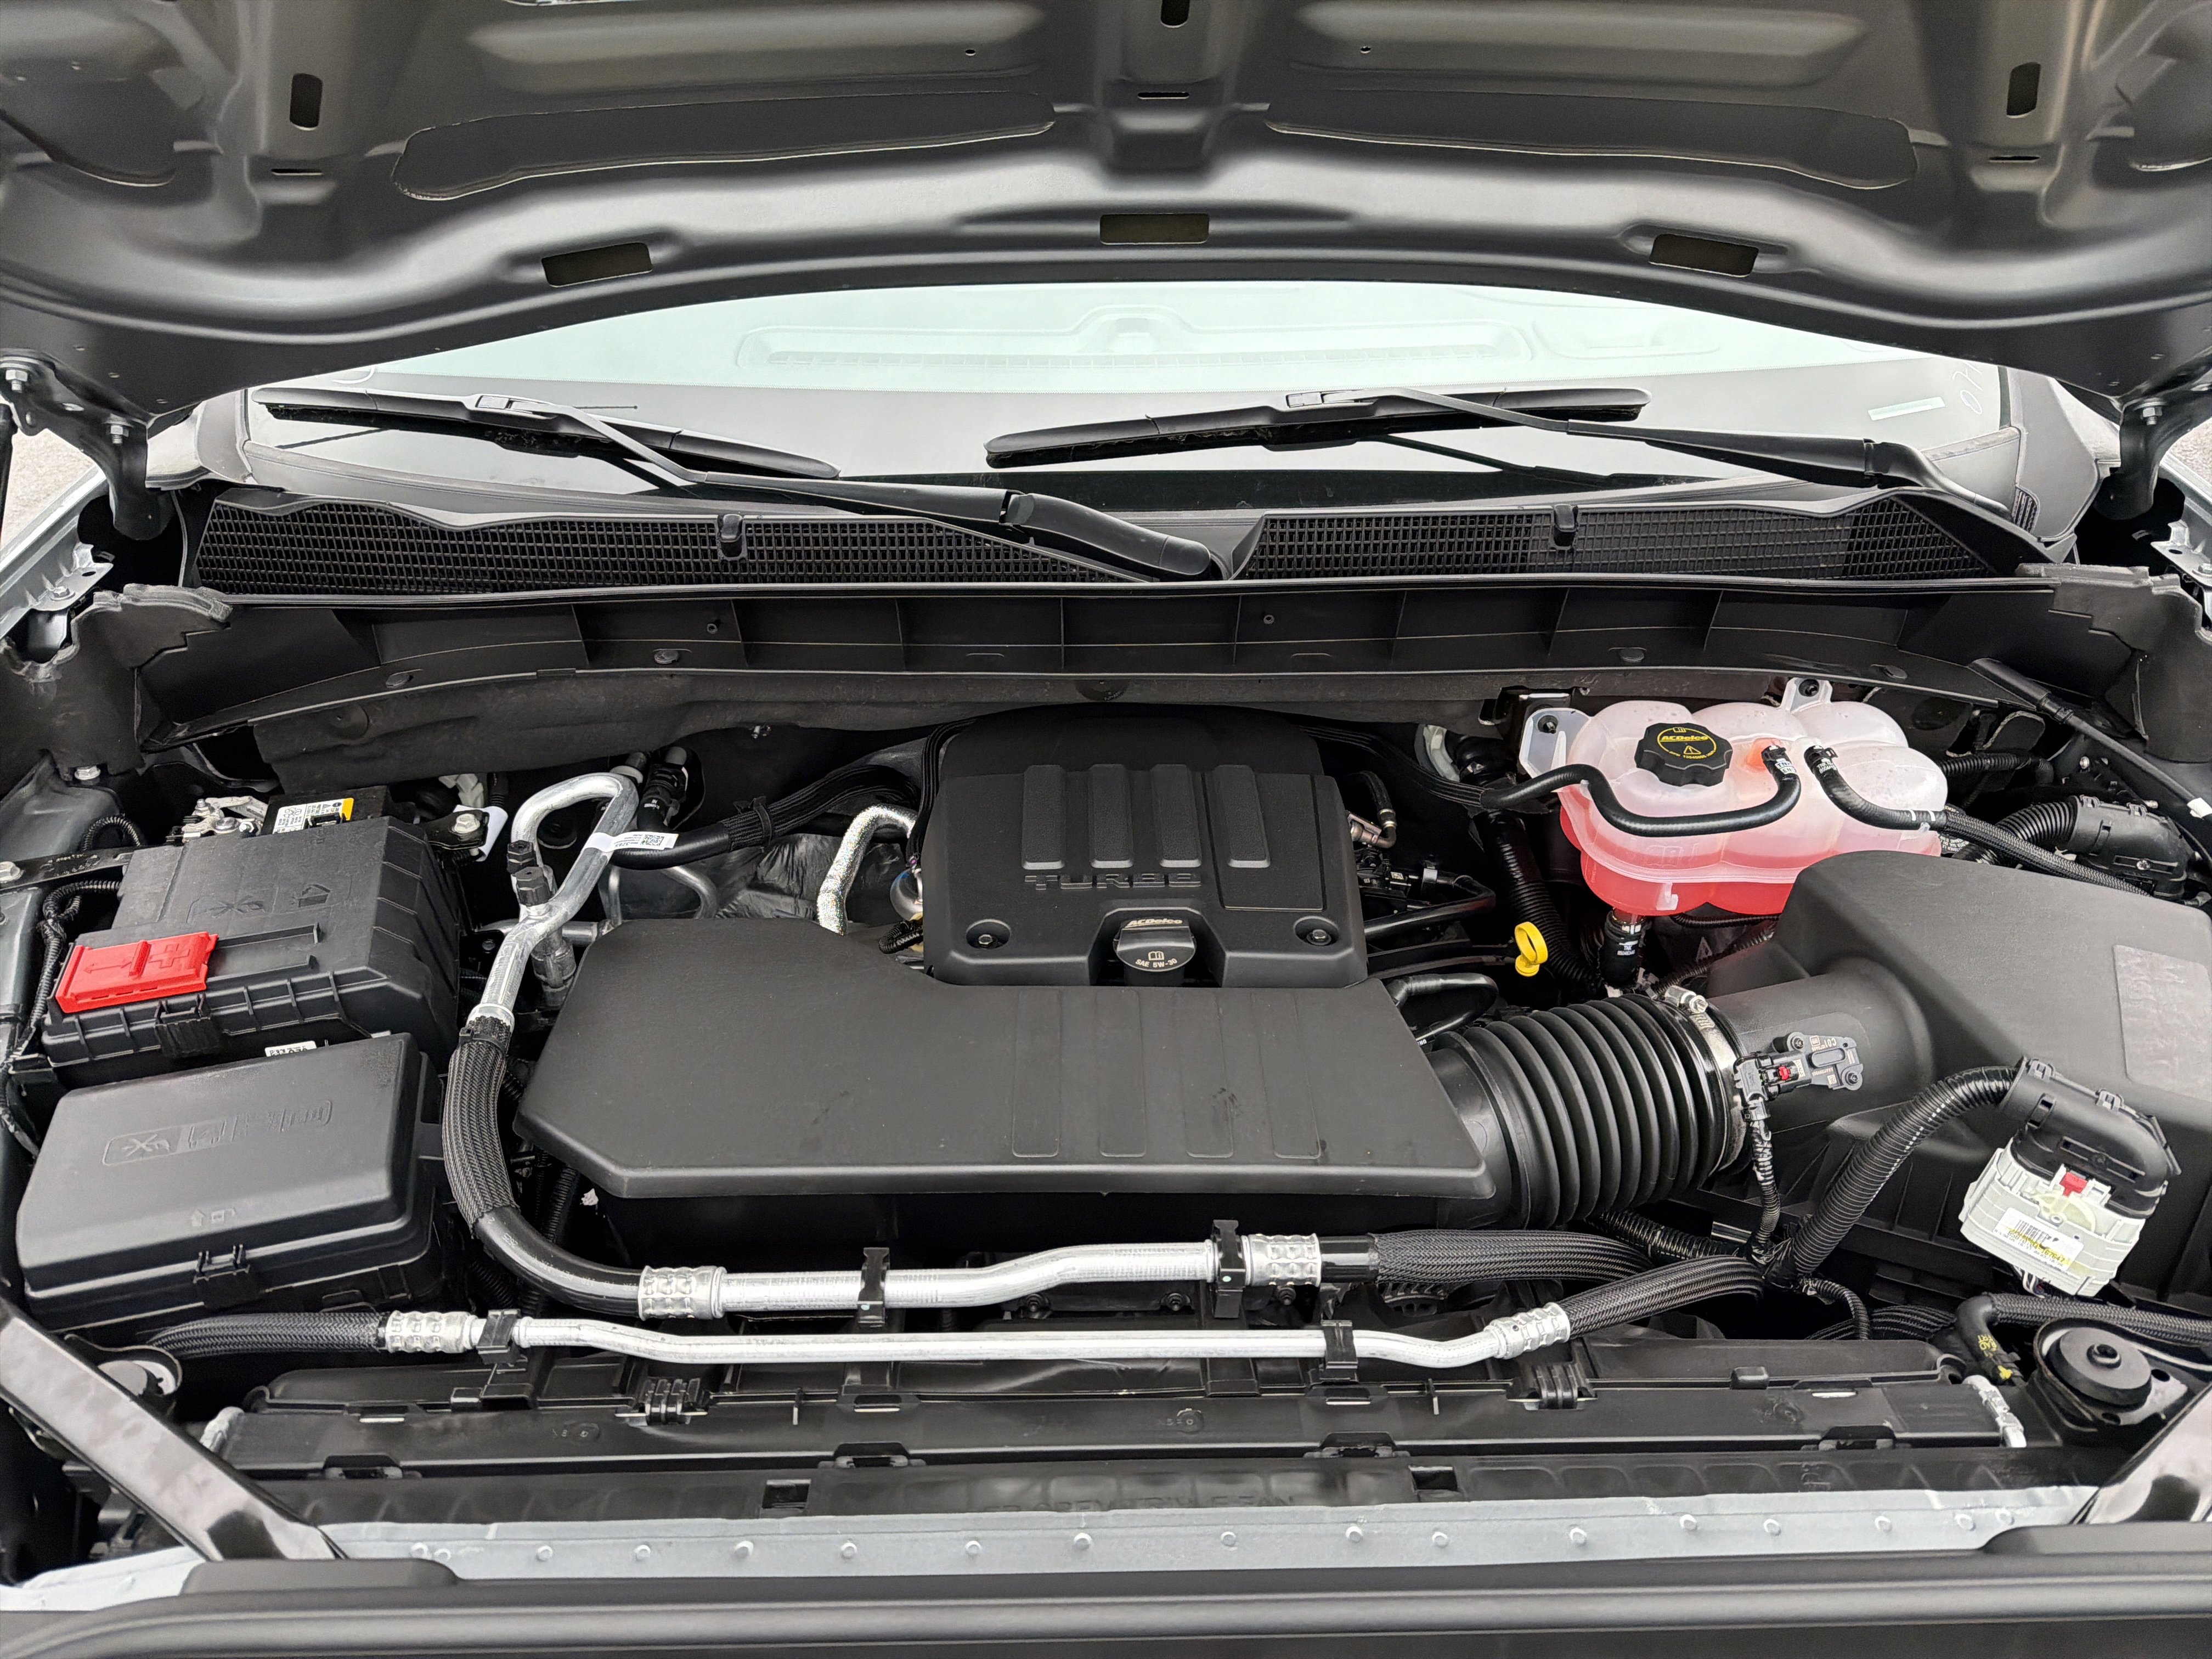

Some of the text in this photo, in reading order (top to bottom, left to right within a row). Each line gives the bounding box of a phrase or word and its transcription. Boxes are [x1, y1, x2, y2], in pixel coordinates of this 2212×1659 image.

[1125, 918, 1183, 928] ACDelco
[1135, 958, 1177, 968] SAE 5W-30
